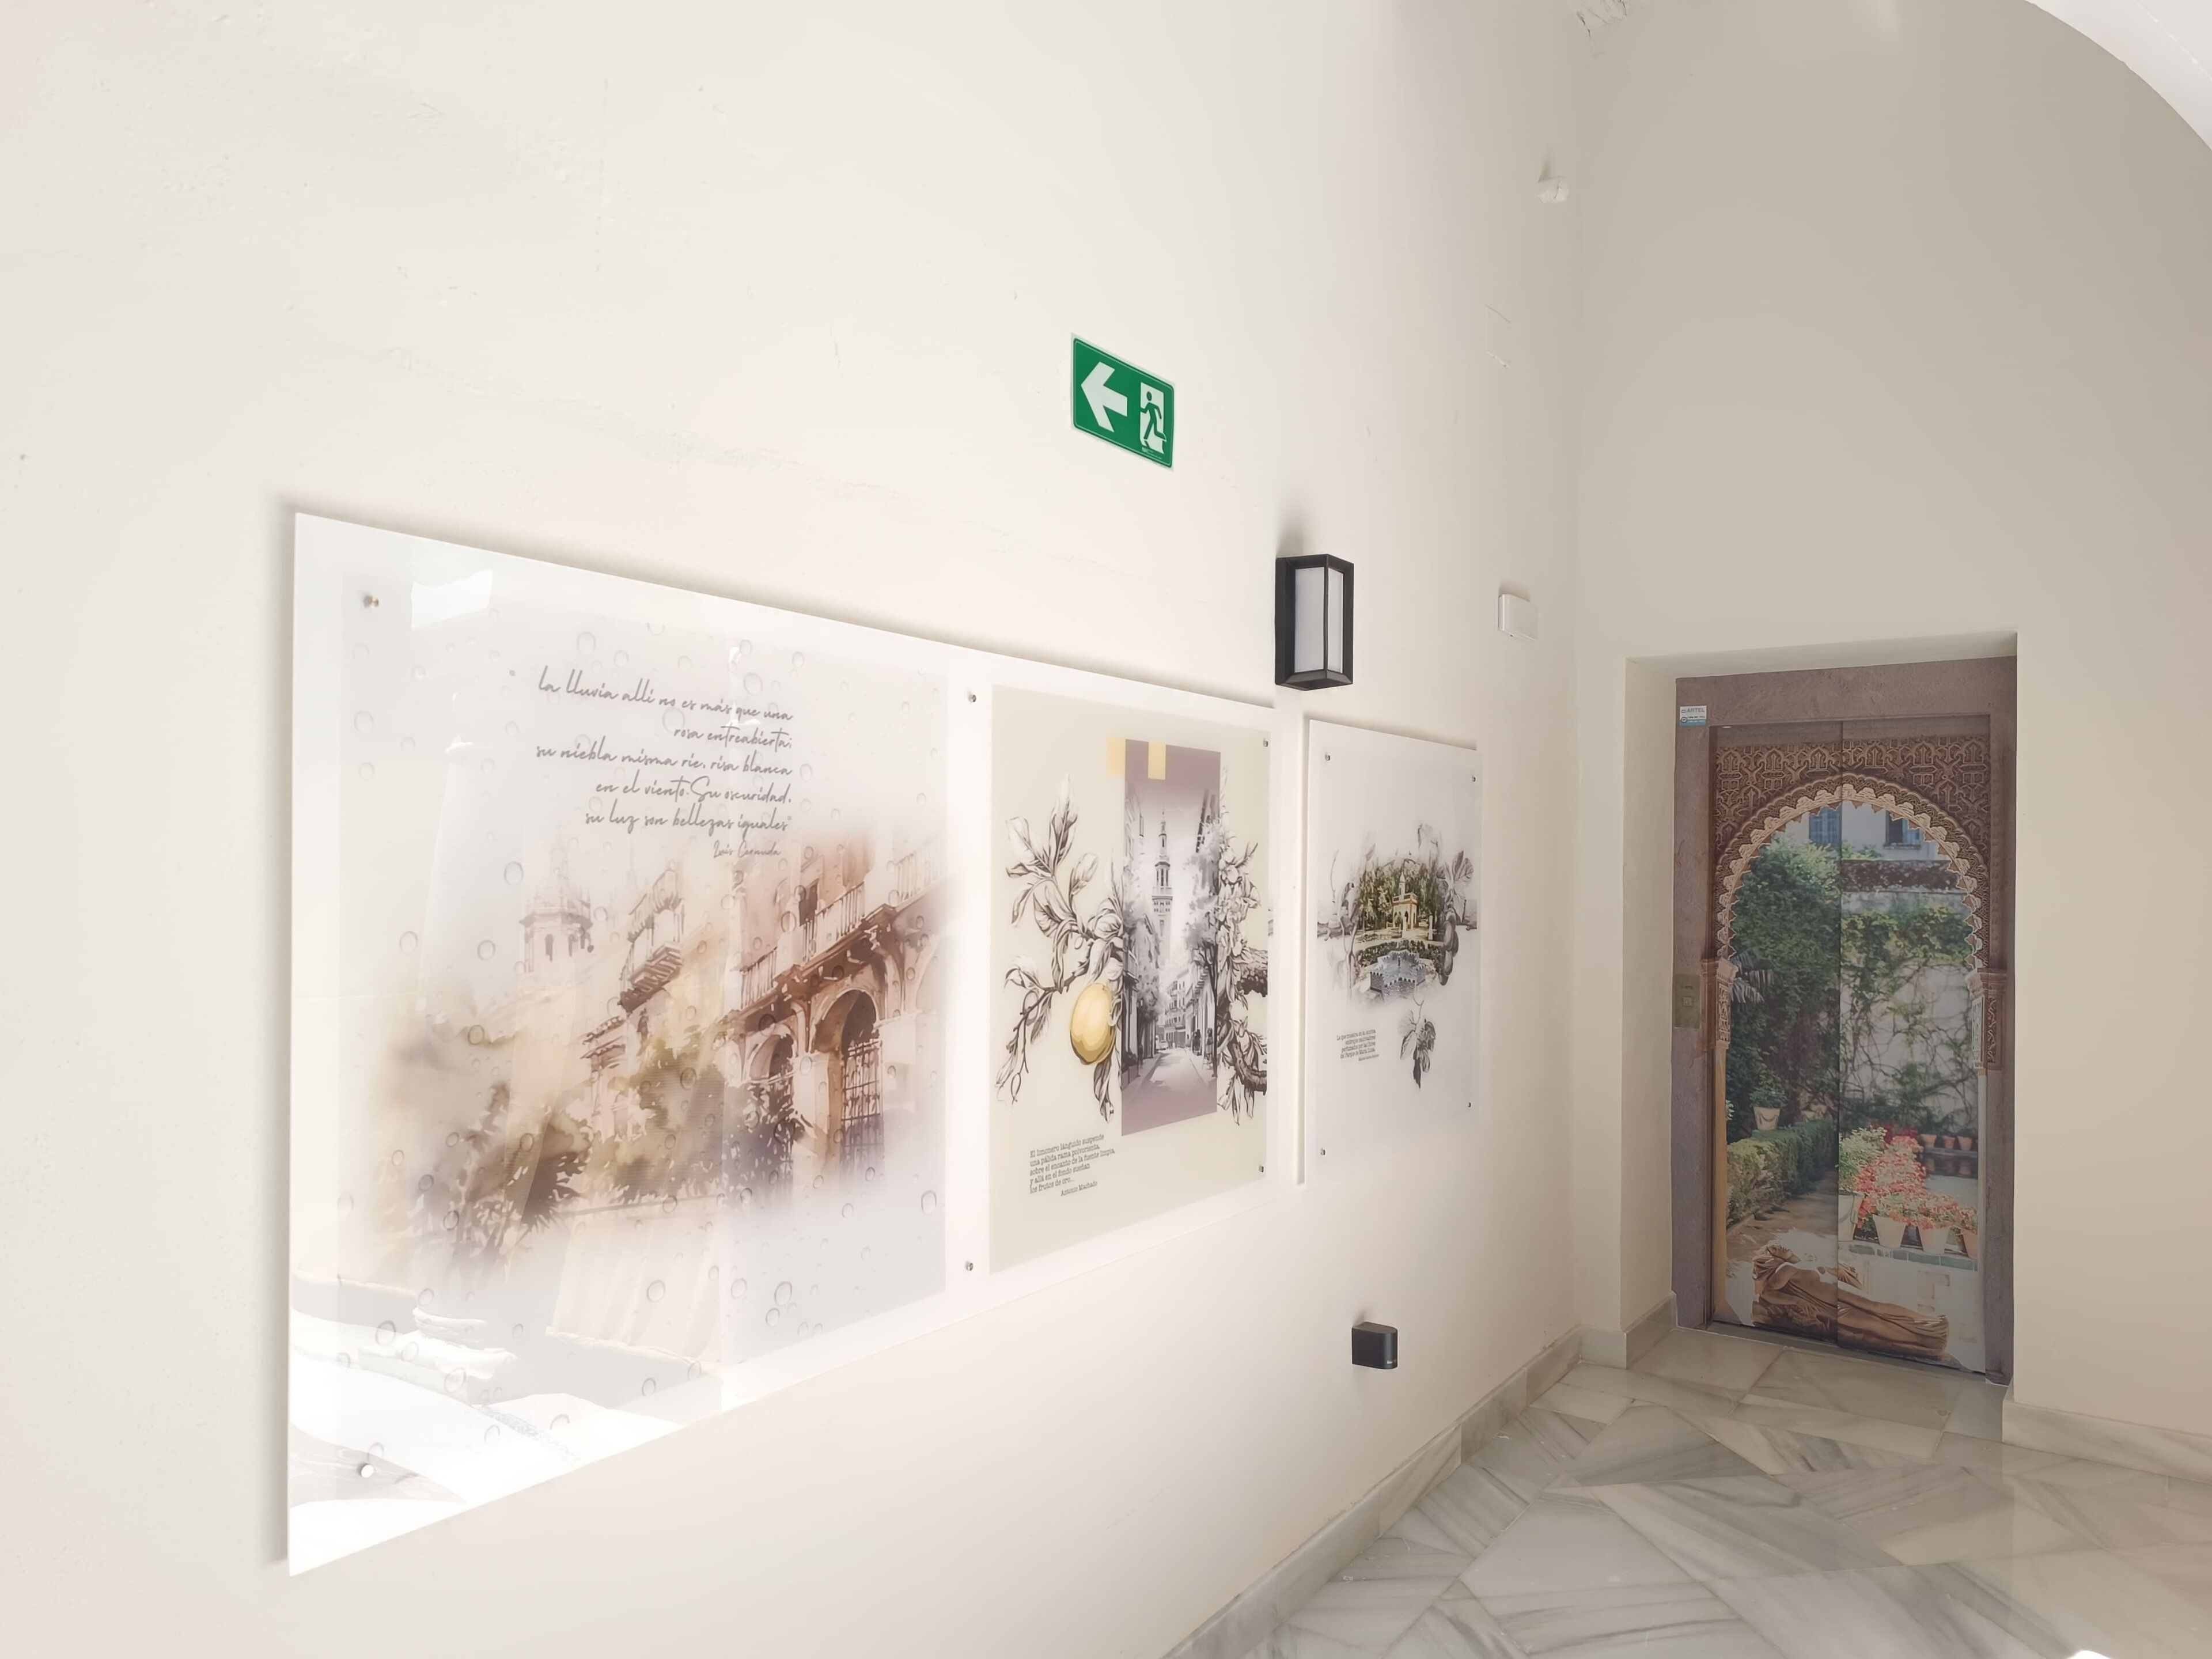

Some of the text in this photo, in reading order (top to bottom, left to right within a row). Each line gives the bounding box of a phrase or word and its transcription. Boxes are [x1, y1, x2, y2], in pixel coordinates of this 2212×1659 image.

[566, 669, 619, 700] lluvia
[658, 698, 676, 707] no
[681, 700, 696, 710] es
[700, 699, 732, 714] más
[736, 706, 761, 721] que
[764, 711, 793, 721] una
[673, 728, 703, 739] rosa
[536, 746, 556, 757] su
[560, 735, 618, 761] niebla
[621, 748, 678, 766] misma
[710, 755, 740, 771] risa
[743, 750, 793, 775] blanca
[596, 783, 620, 793] en
[623, 769, 641, 793] el
[690, 775, 722, 802] Su
[585, 813, 605, 824] su
[609, 798, 640, 835] luz
[645, 816, 668, 826] son
[672, 802, 734, 836] bellezas
[1036, 1145, 1059, 1156] limonero
[1082, 1134, 1104, 1145] suspende
[1058, 1152, 1071, 1160] rama
[1029, 1167, 1044, 1176] sobre
[1051, 1160, 1071, 1171] encanto
[1084, 1152, 1099, 1161] fuente
[1058, 1167, 1072, 1177] fondo
[1029, 1184, 1037, 1194] los
[1038, 1181, 1054, 1191] frutos
[1060, 1185, 1078, 1196] Antonio
